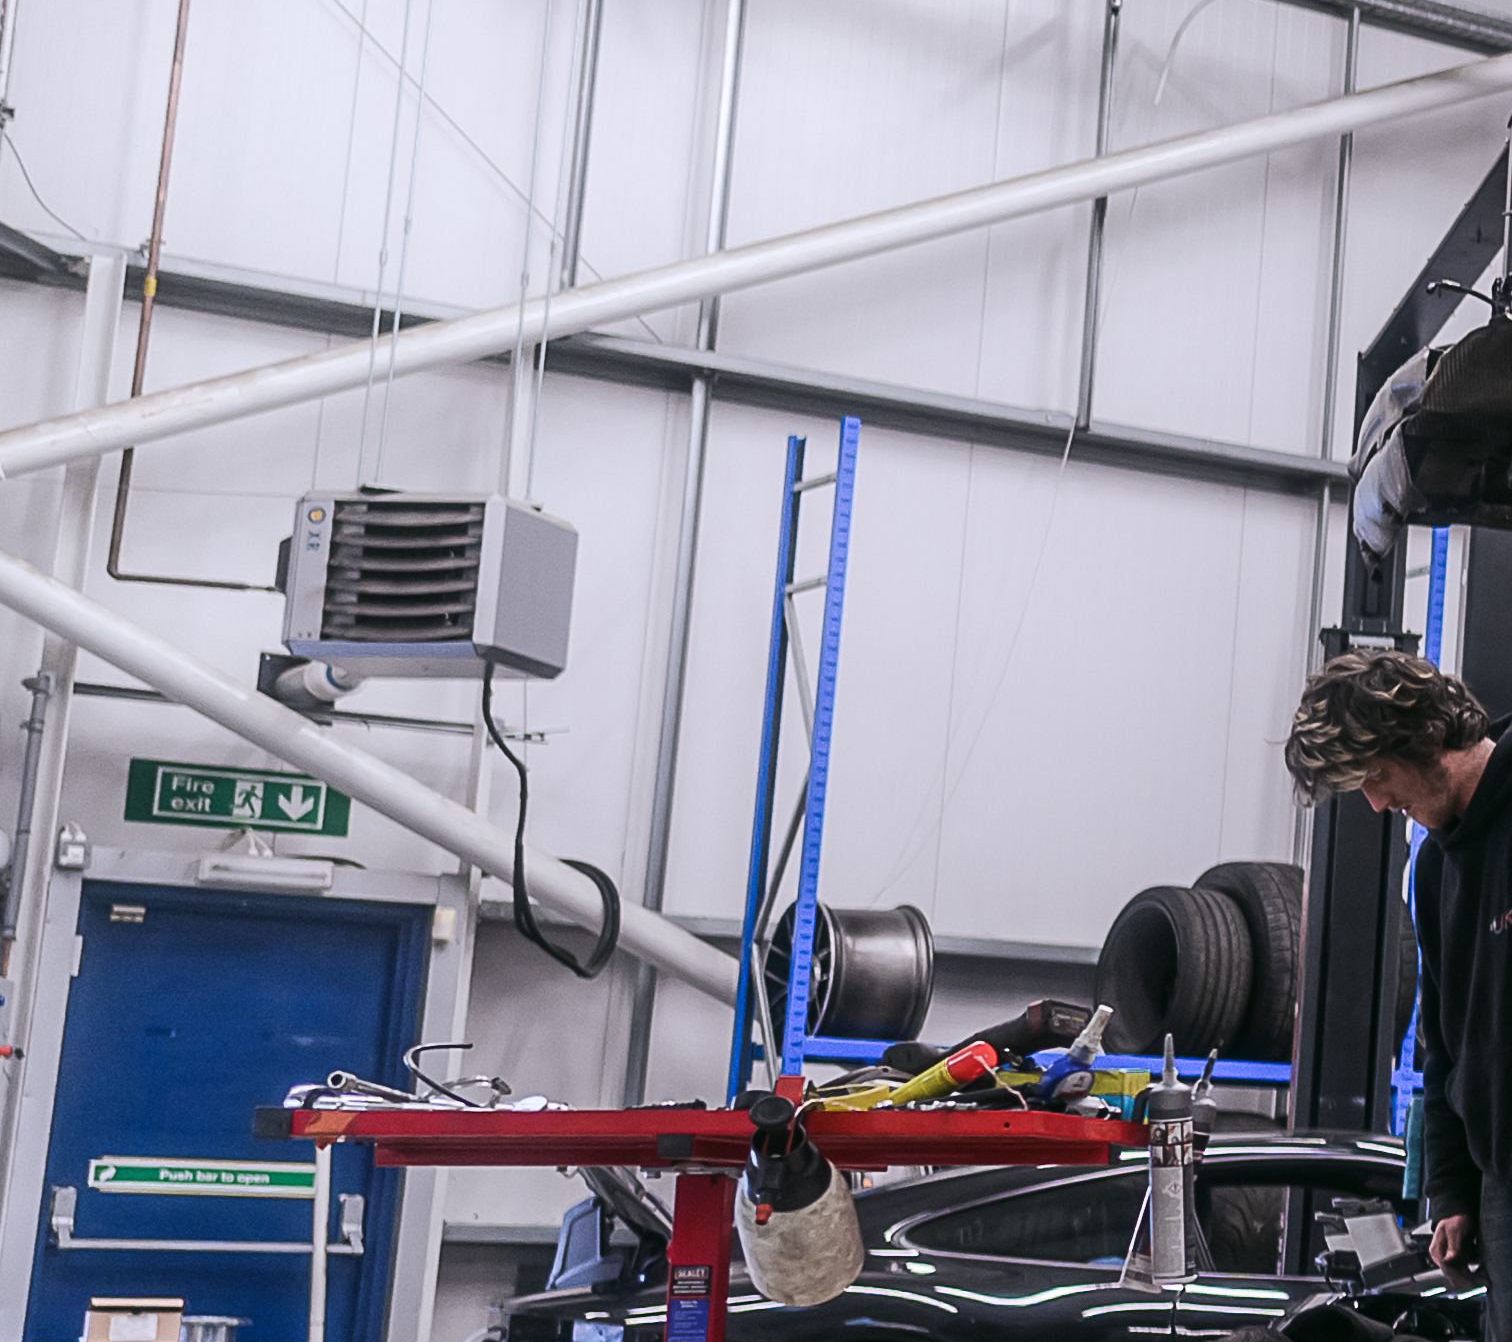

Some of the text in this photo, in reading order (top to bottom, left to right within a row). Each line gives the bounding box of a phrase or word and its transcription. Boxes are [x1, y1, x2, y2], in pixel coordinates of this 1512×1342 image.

[171, 775, 216, 794] Fire
[171, 797, 211, 812] exit
[159, 1168, 270, 1186] Push bar to open
